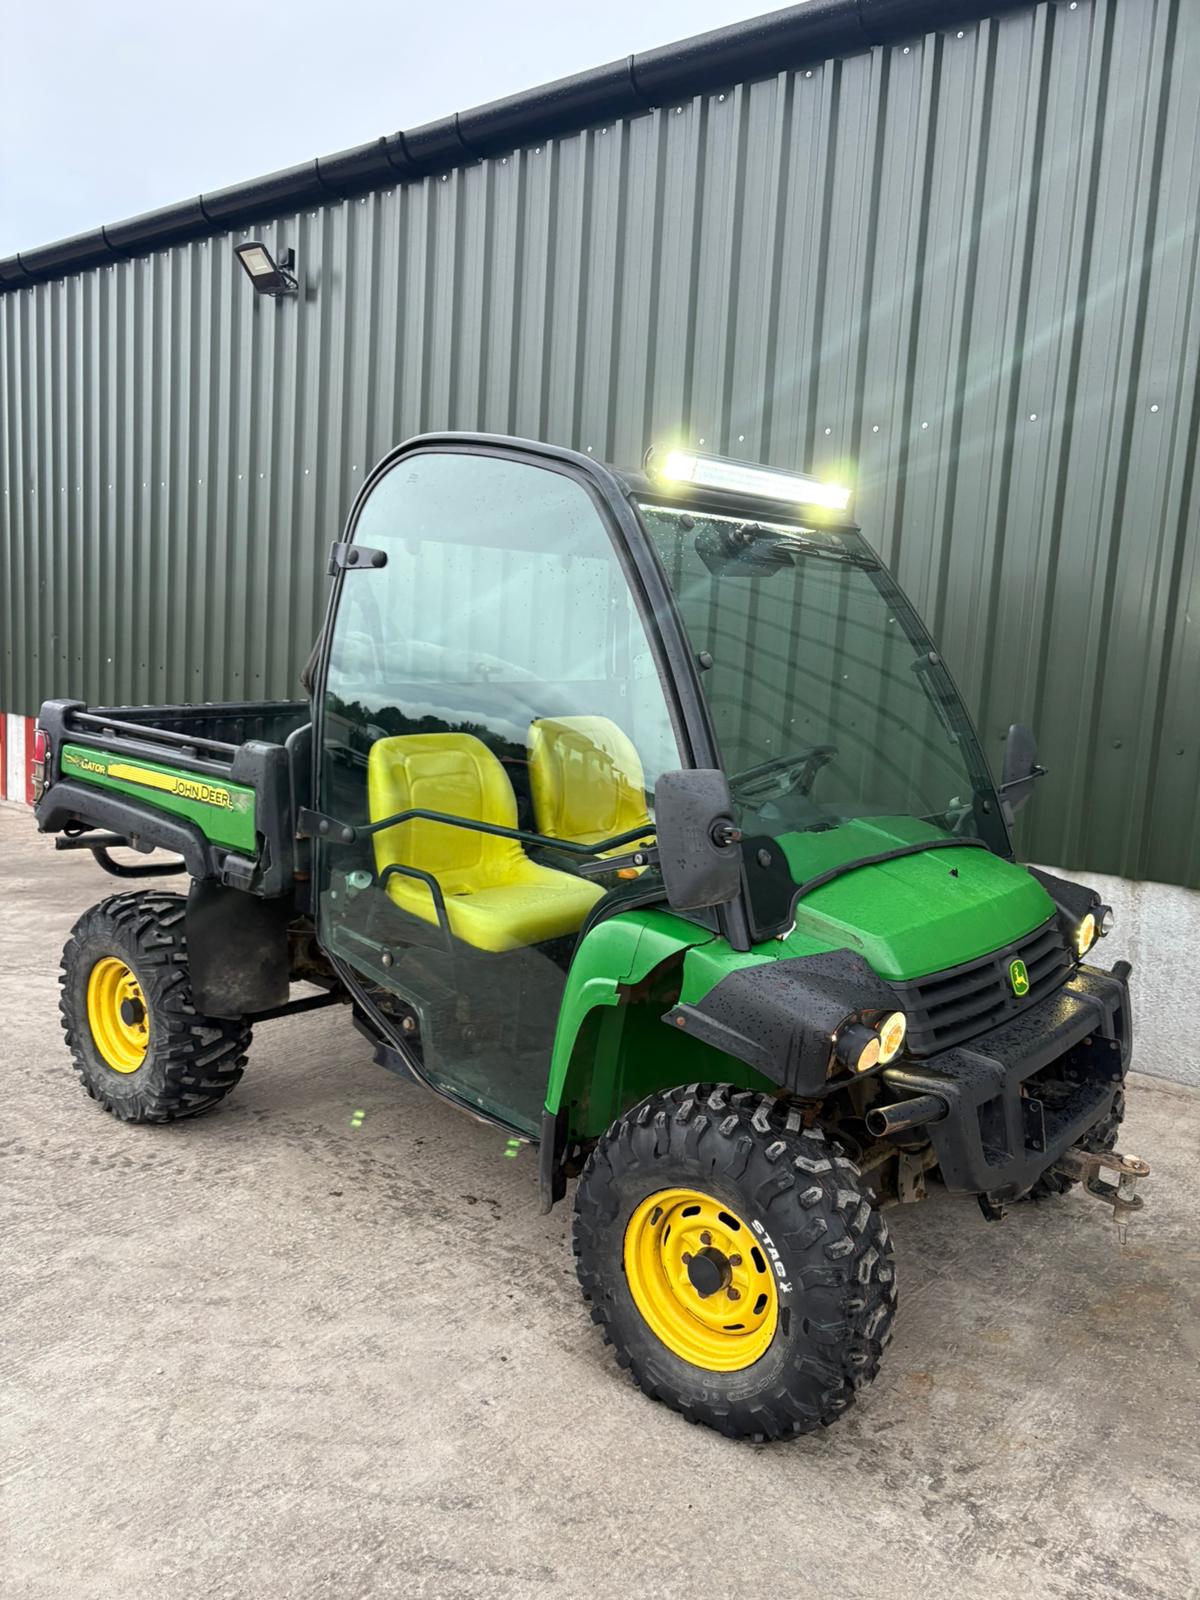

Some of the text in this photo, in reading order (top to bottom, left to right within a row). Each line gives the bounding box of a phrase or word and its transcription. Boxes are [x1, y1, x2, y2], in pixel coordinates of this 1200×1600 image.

[81, 758, 106, 774] GATOR
[171, 779, 199, 799] JOHN
[751, 1219, 786, 1277] STAG
